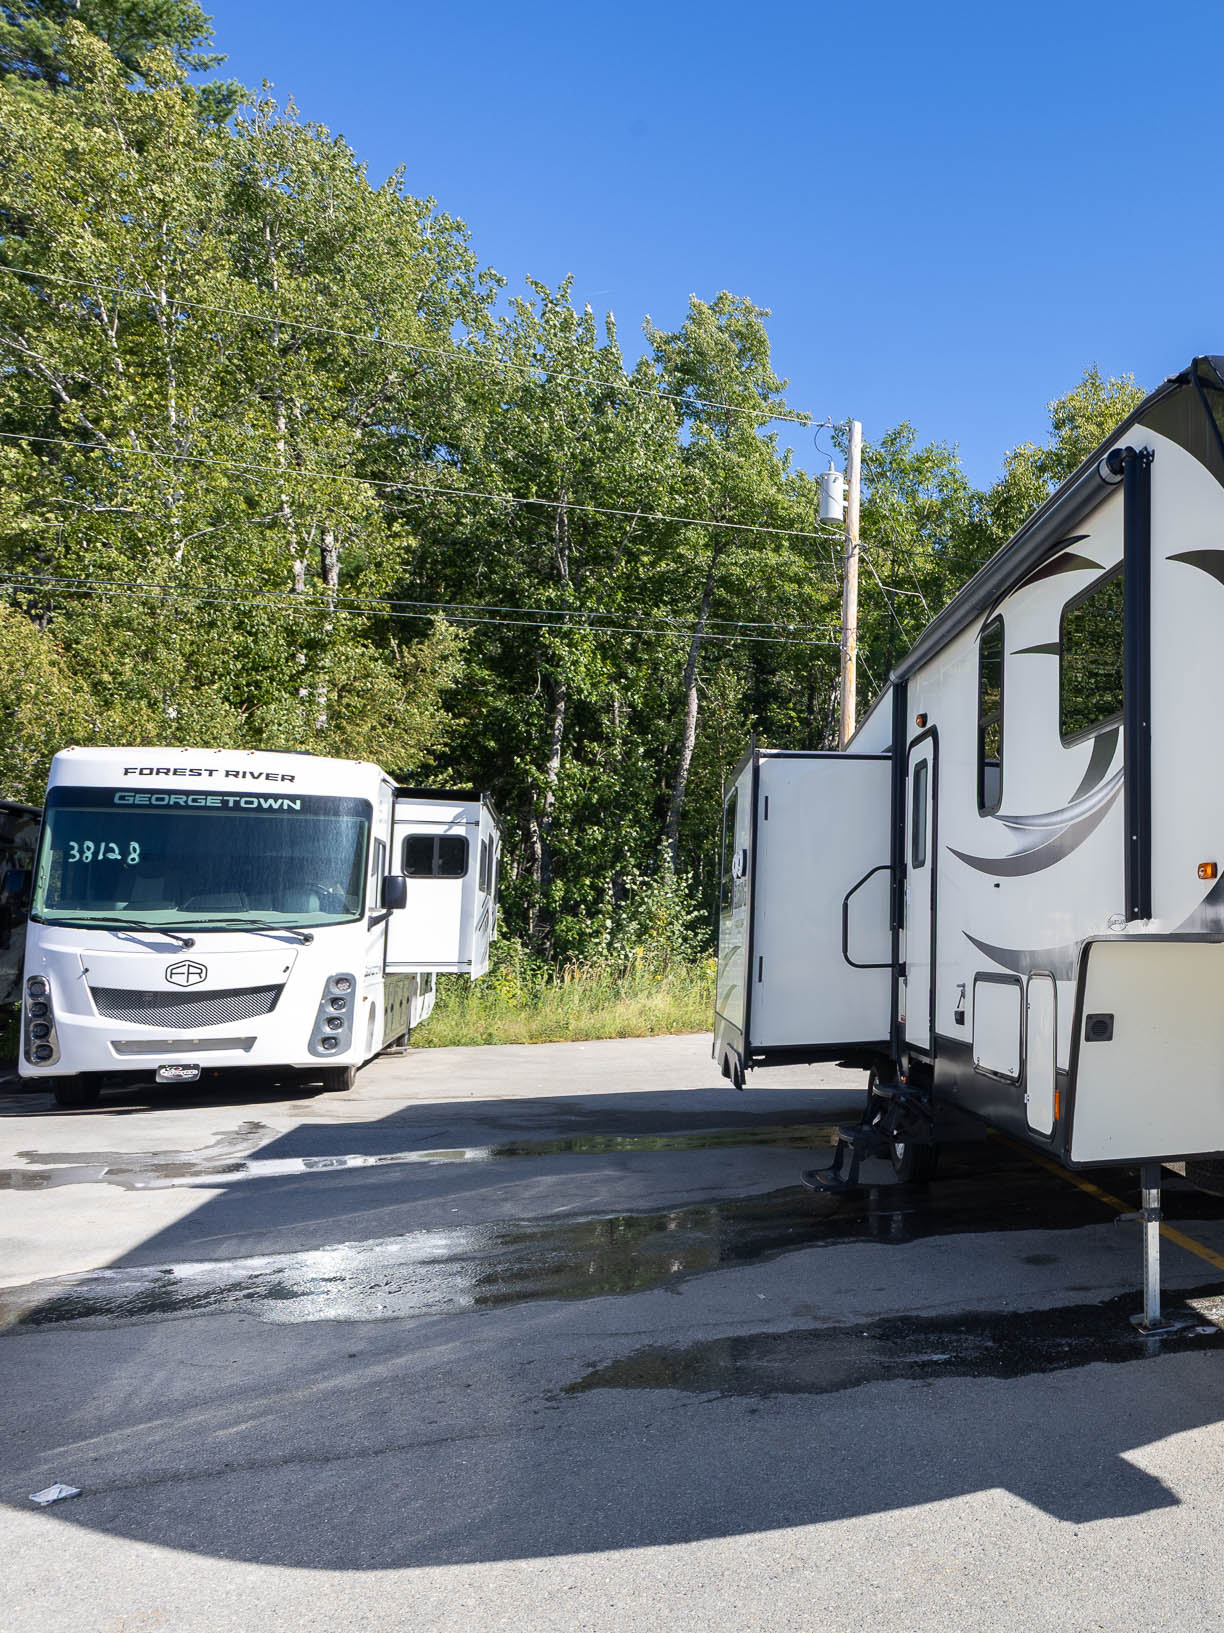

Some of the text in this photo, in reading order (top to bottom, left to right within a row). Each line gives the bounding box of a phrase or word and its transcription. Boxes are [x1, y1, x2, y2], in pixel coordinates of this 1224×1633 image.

[122, 767, 296, 783] FOREST RIVER
[113, 791, 301, 811] GEORGETOWN
[67, 840, 140, 865] 38128
